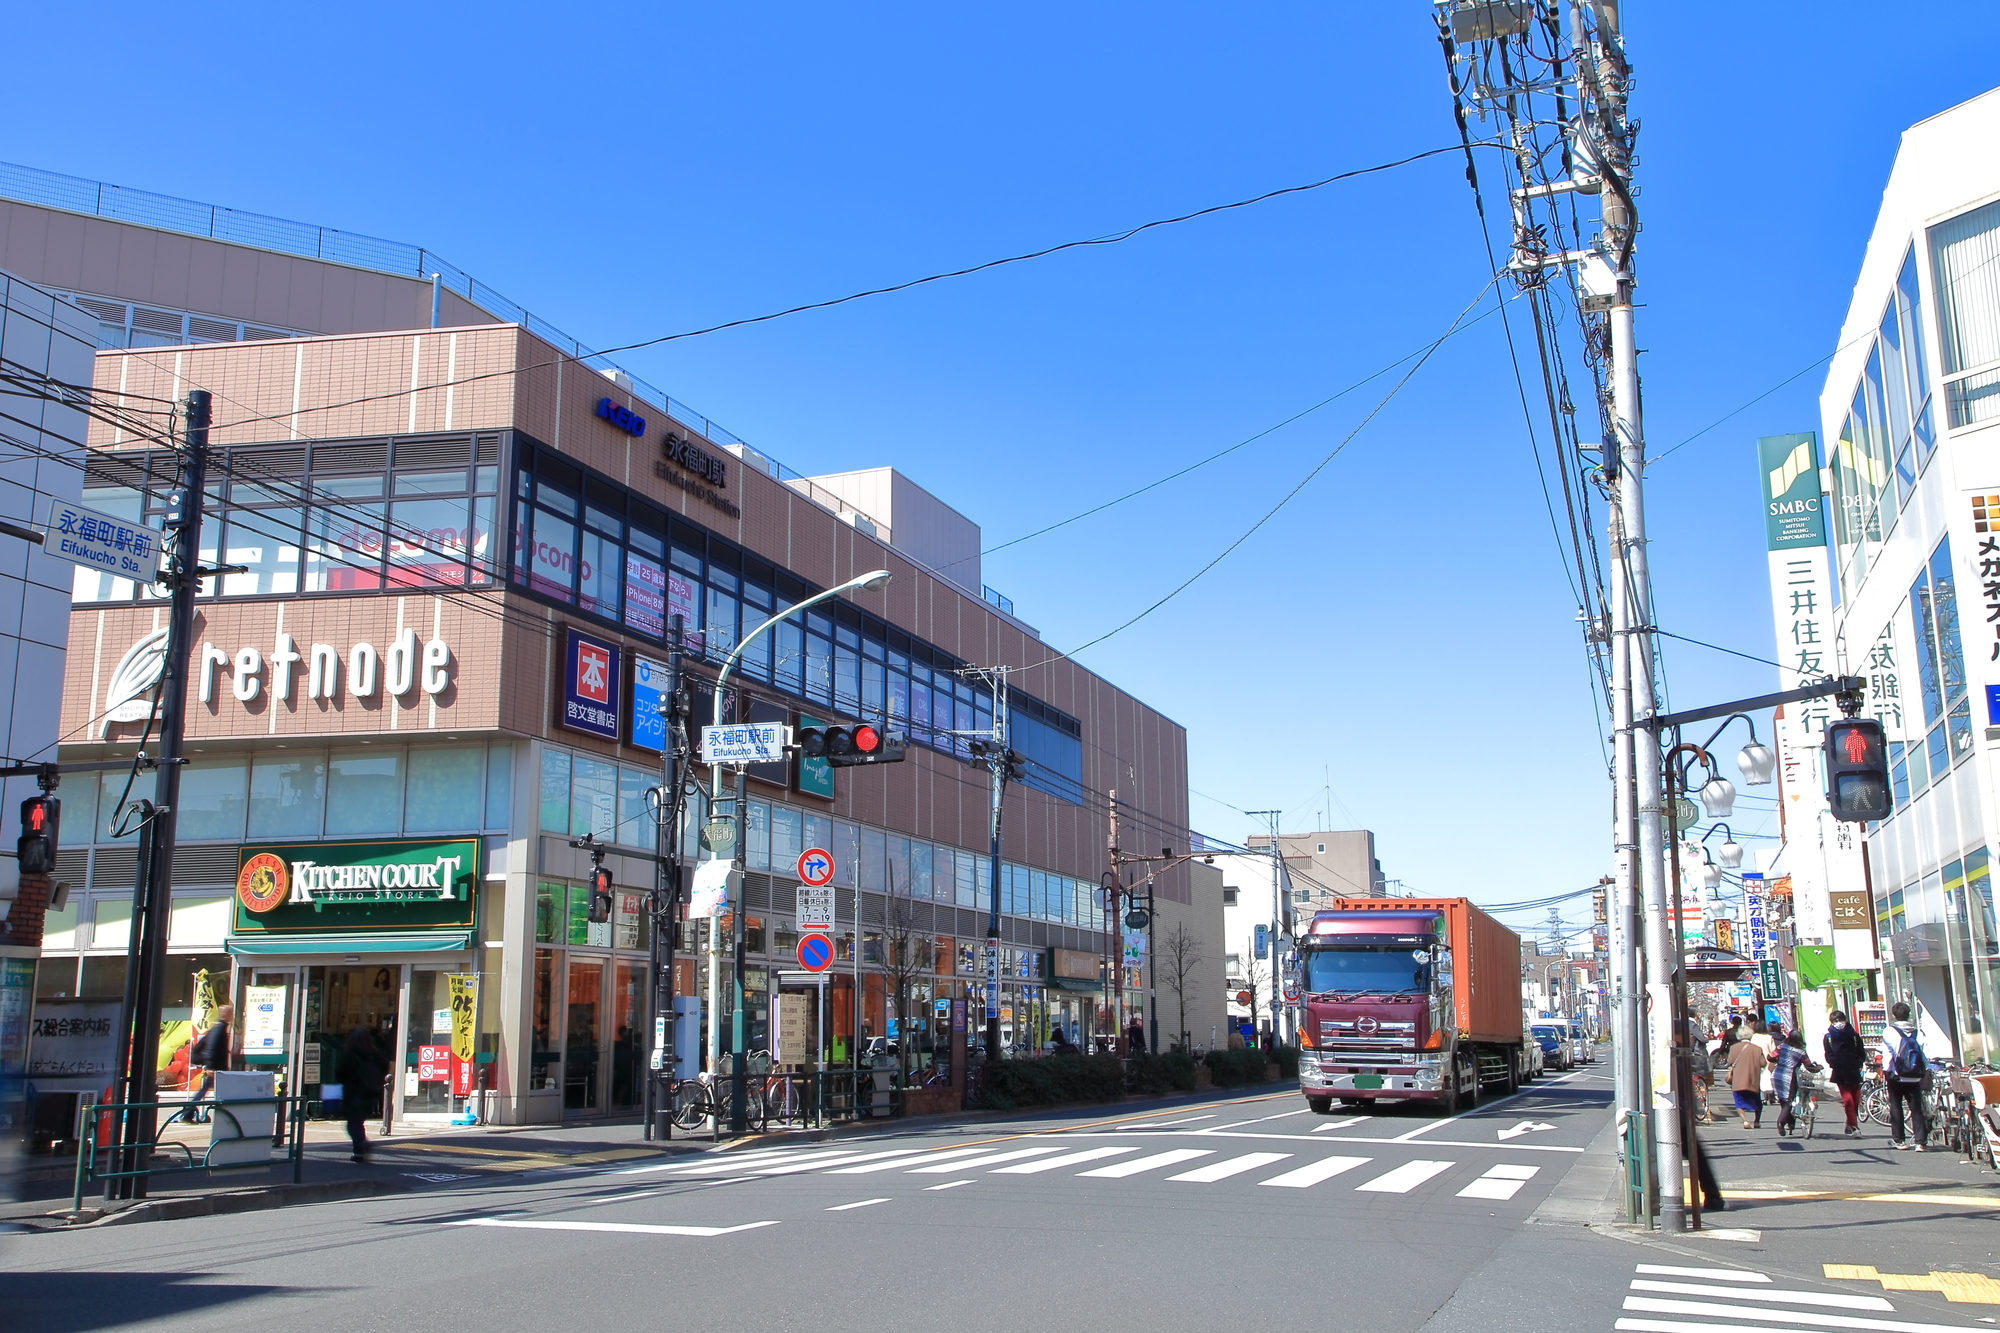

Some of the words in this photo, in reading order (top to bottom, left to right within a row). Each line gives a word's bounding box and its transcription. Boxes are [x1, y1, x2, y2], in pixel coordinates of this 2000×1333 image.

[596, 397, 646, 437] KEIO
[666, 431, 727, 489] 永福町駅
[656, 460, 705, 500] Eifukucho
[707, 488, 741, 520] Station
[1769, 498, 1818, 516] SMBC
[1779, 516, 1811, 524] SUMITOMO
[58, 509, 152, 559] 永福町駅前
[337, 523, 481, 554] docomo
[1775, 533, 1817, 541] CORPORATION
[60, 538, 117, 567] Eifukucho
[120, 556, 142, 574] Sta.
[200, 627, 449, 703] retnode
[581, 652, 605, 693] 本
[567, 701, 616, 730] 啓文堂書店
[709, 728, 775, 747] 永福町駅前
[713, 746, 752, 757] Eifukucho
[755, 744, 771, 755] Sta.
[702, 826, 734, 842] 永福町
[1837, 820, 1852, 850] 村歯科
[251, 857, 282, 876] FRESH
[289, 861, 382, 903] KITCHEN
[382, 855, 461, 900] COURT
[241, 872, 260, 908] QUALITY
[260, 882, 283, 907] FOODS
[328, 891, 364, 901] KEIO
[374, 891, 424, 900] STORE
[1837, 895, 1861, 905] café
[1748, 895, 1767, 959] 英才個別学院
[1834, 906, 1866, 918] こはく
[1767, 967, 1778, 997] 岡本眼科
